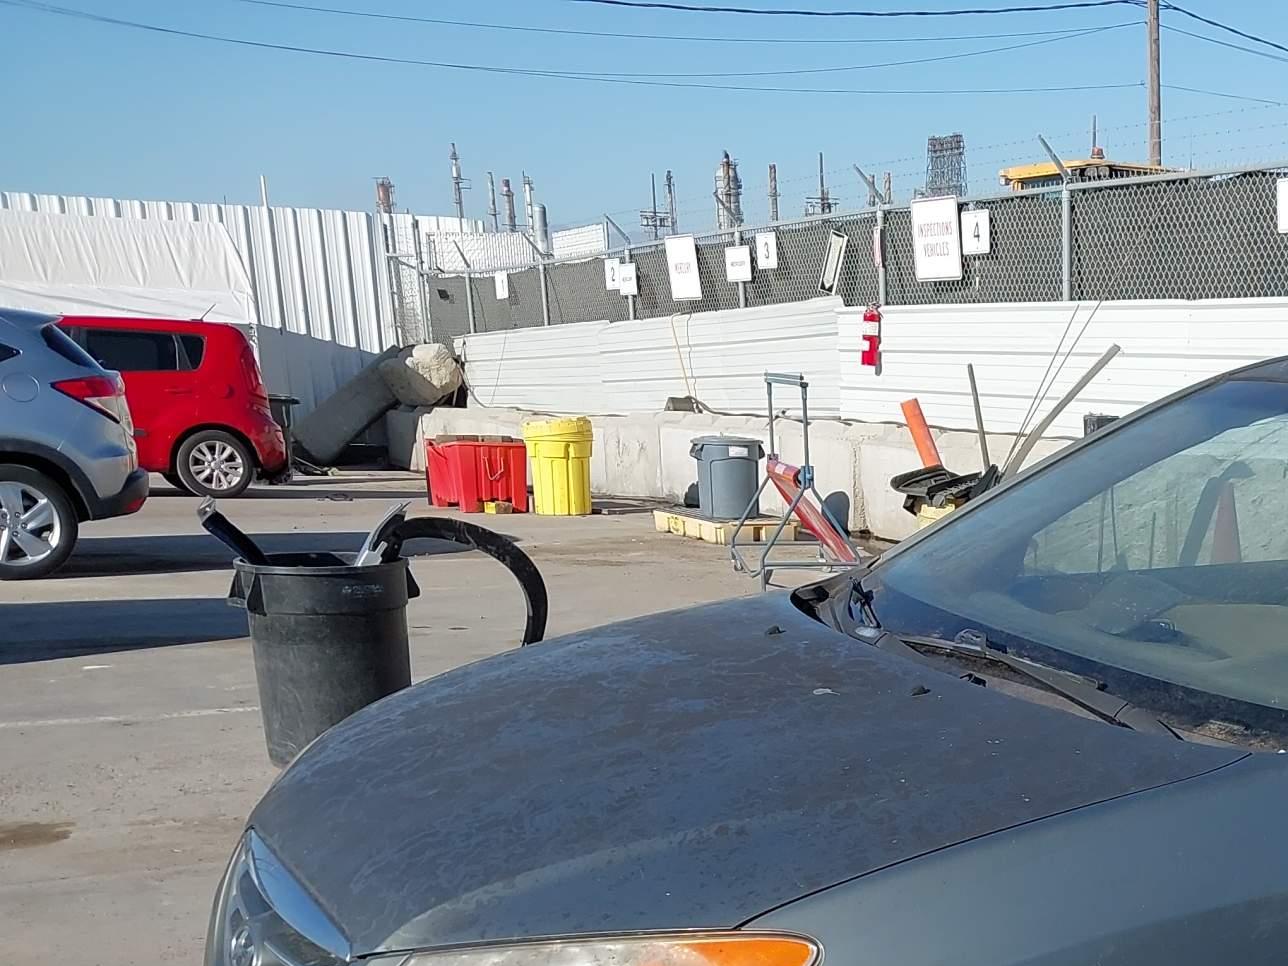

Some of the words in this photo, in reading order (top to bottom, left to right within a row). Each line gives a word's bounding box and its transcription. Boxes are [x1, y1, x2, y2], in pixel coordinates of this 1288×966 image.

[917, 221, 953, 238] INSPECTIONS
[973, 221, 980, 242] 4
[764, 241, 770, 259] 3
[923, 241, 949, 258] VEHICLES
[610, 266, 616, 282] 2
